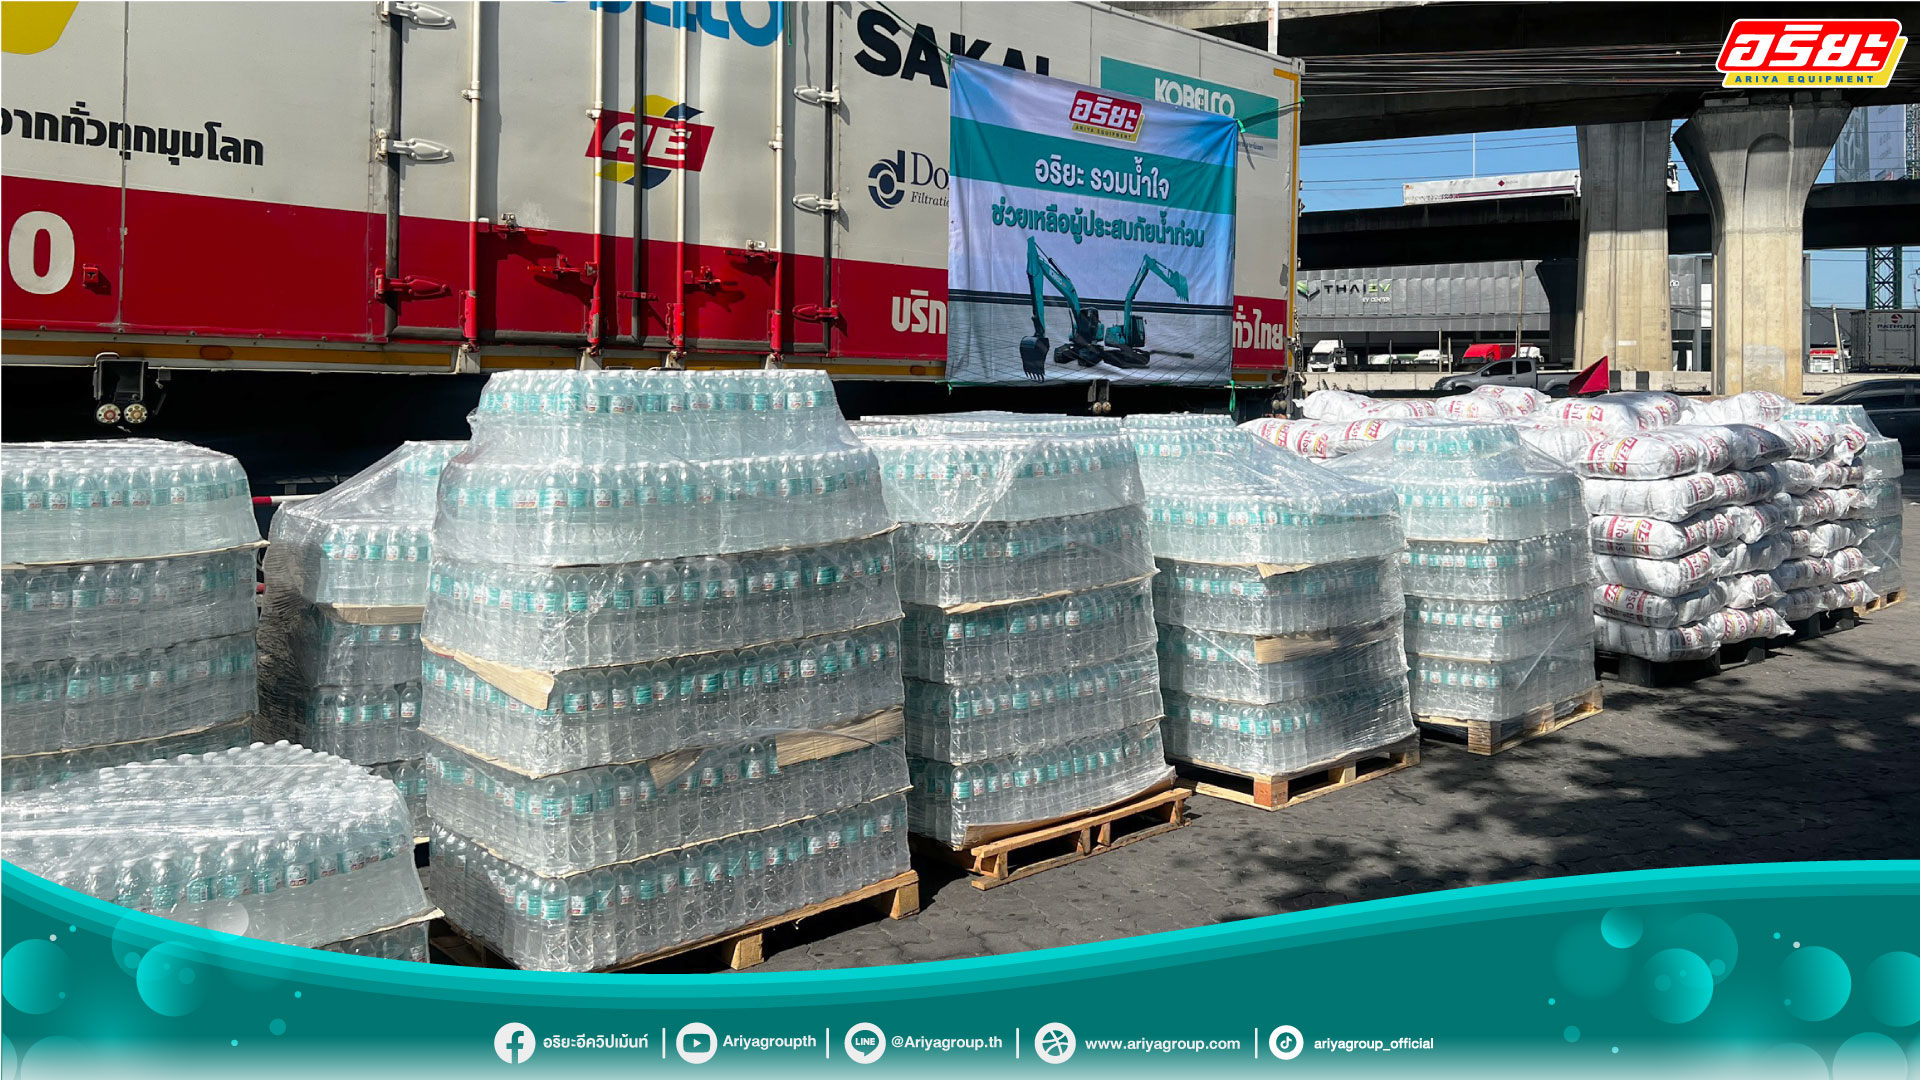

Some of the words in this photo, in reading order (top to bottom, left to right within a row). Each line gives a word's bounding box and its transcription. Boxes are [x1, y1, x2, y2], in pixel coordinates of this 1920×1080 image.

[1072, 96, 1138, 130] อริยะ
[911, 152, 949, 190] Do
[1035, 154, 1085, 186] อริยะ
[1090, 156, 1170, 200] รวมน้ำใจ
[991, 196, 1205, 248] ช่วยเหลือผู้ประสบภัยน้ำท่วม
